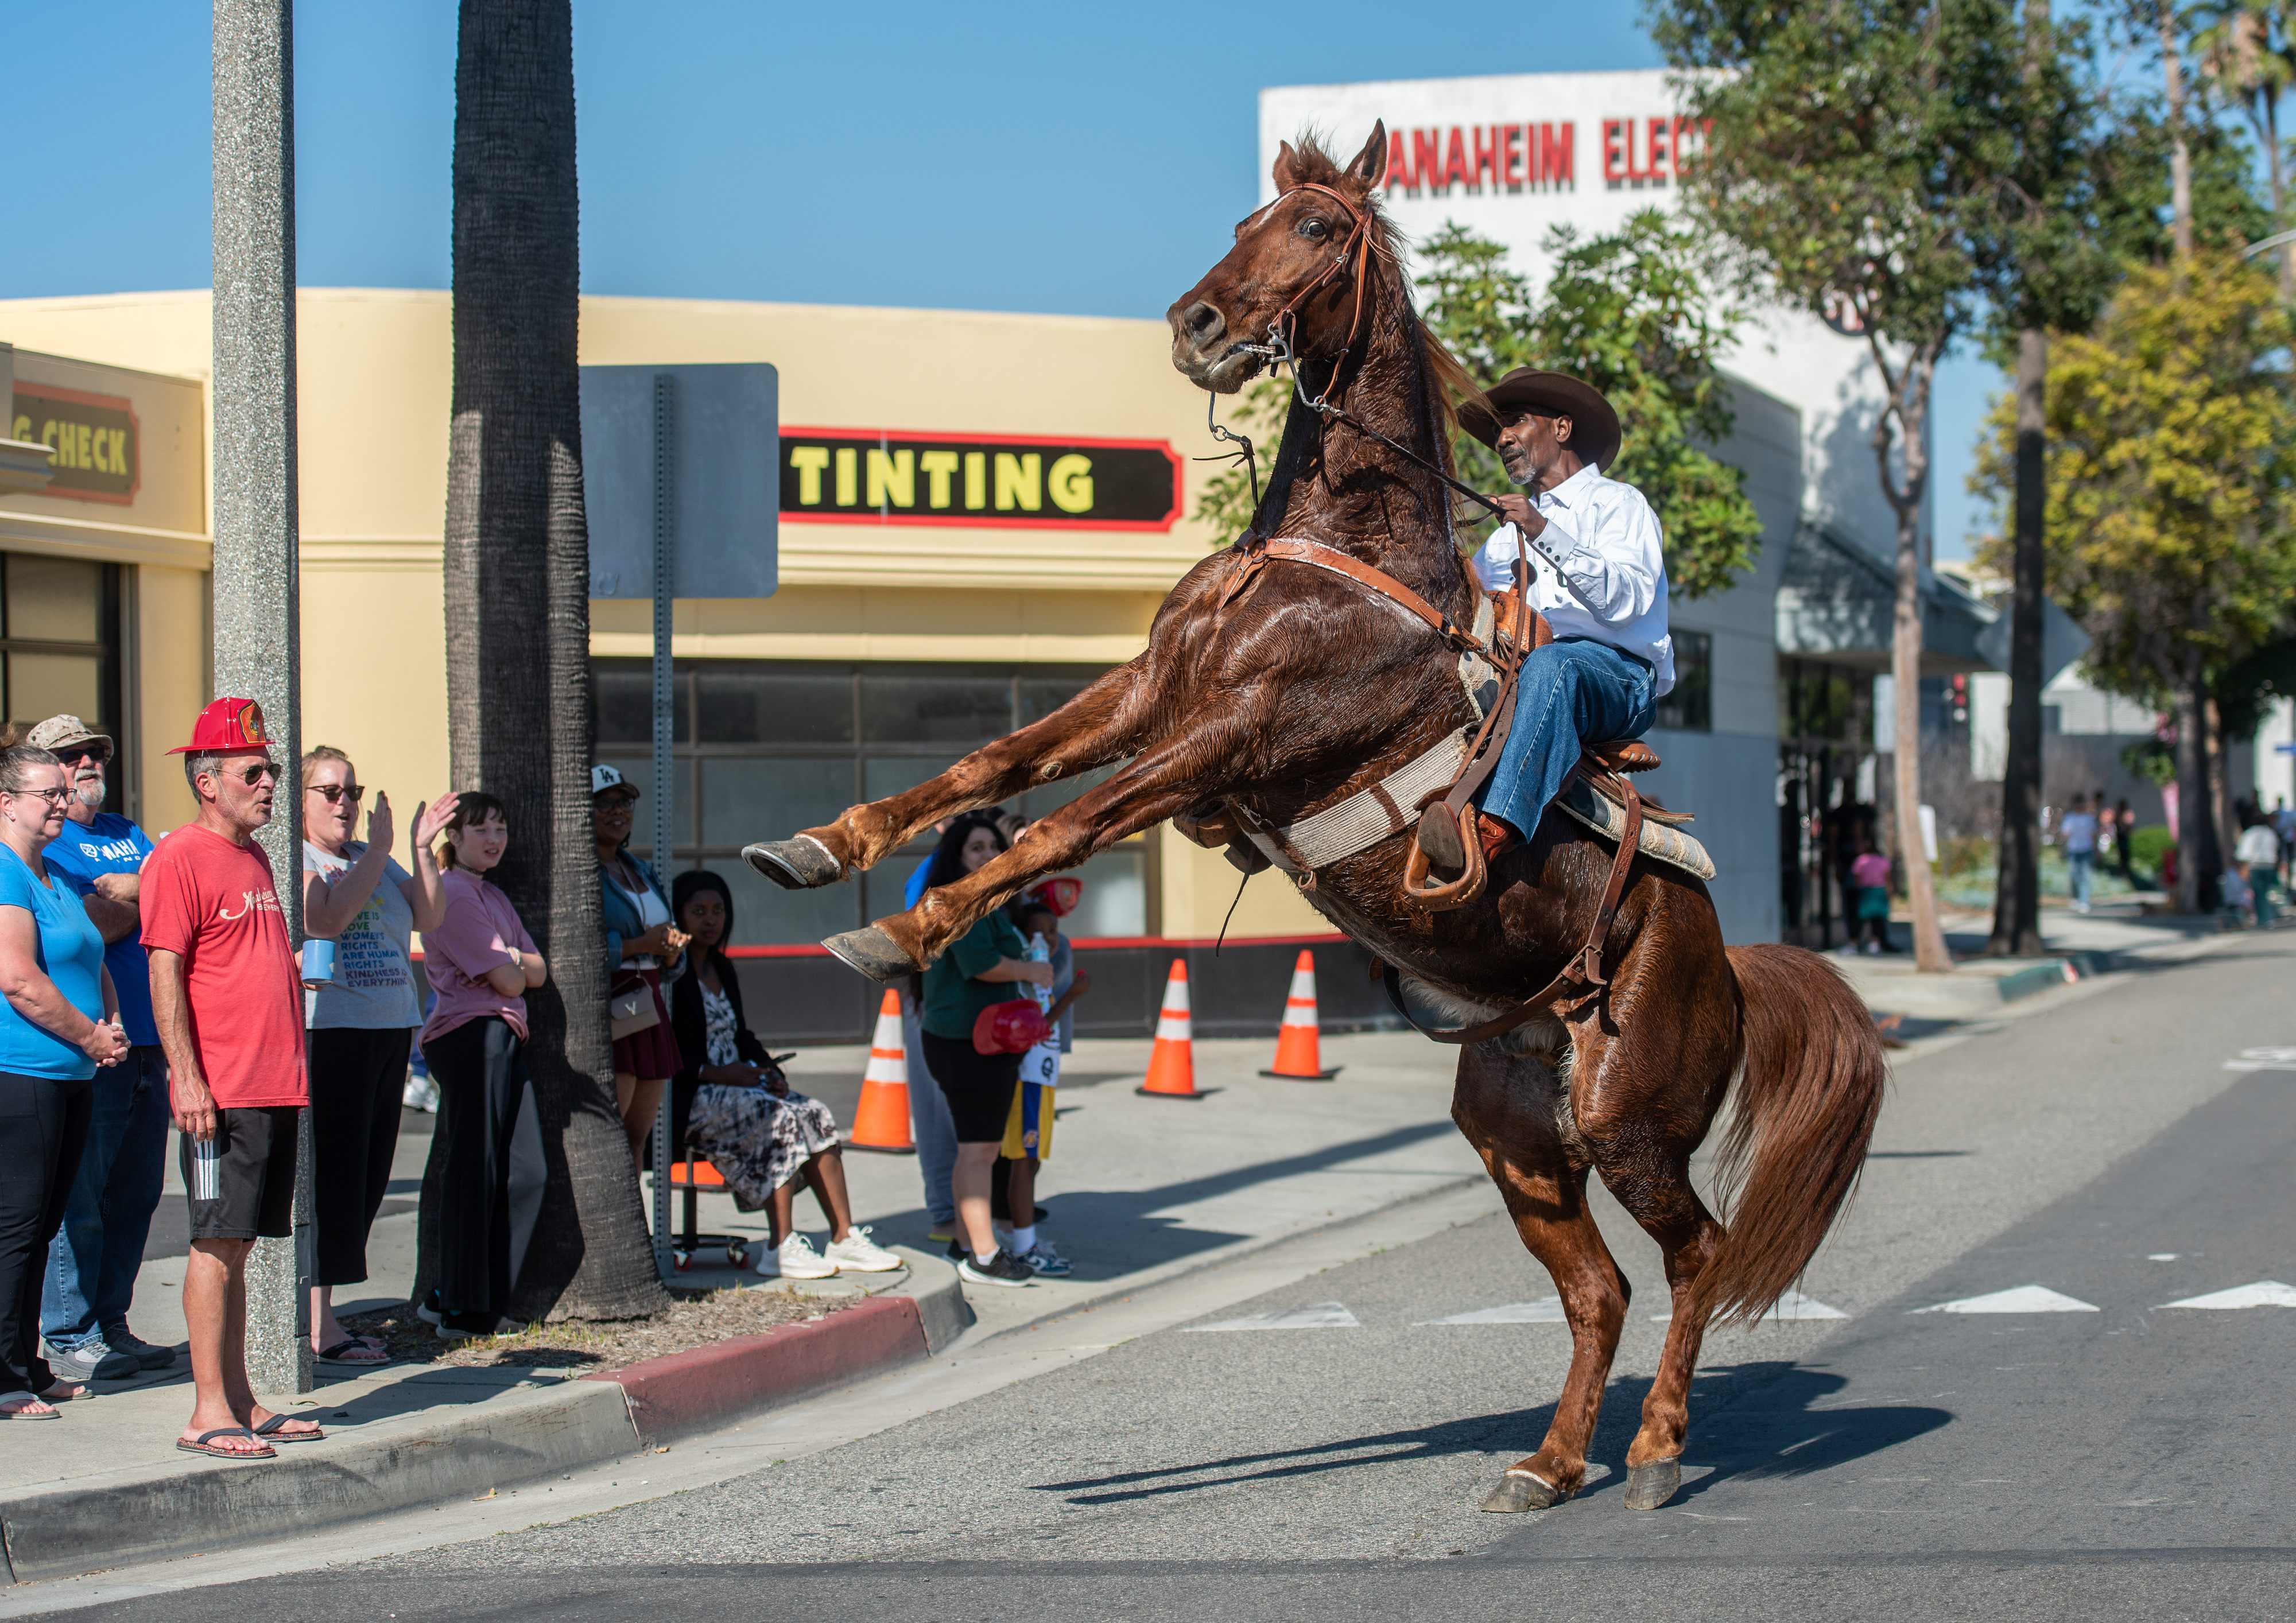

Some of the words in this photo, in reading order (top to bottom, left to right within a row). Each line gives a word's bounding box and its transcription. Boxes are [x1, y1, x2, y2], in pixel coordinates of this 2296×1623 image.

[1383, 121, 1574, 192] ANAHEIM
[42, 418, 127, 476] CHECK
[790, 446, 1094, 513] TINTING
[599, 768, 614, 782] LA
[372, 912, 379, 921] IS
[344, 922, 370, 932] OVE
[340, 942, 379, 950] RIGHTS
[343, 951, 365, 960] ARE
[367, 950, 400, 959] HUMAN
[344, 960, 385, 969] RIGHTS
[346, 968, 400, 980] KINDNESS
